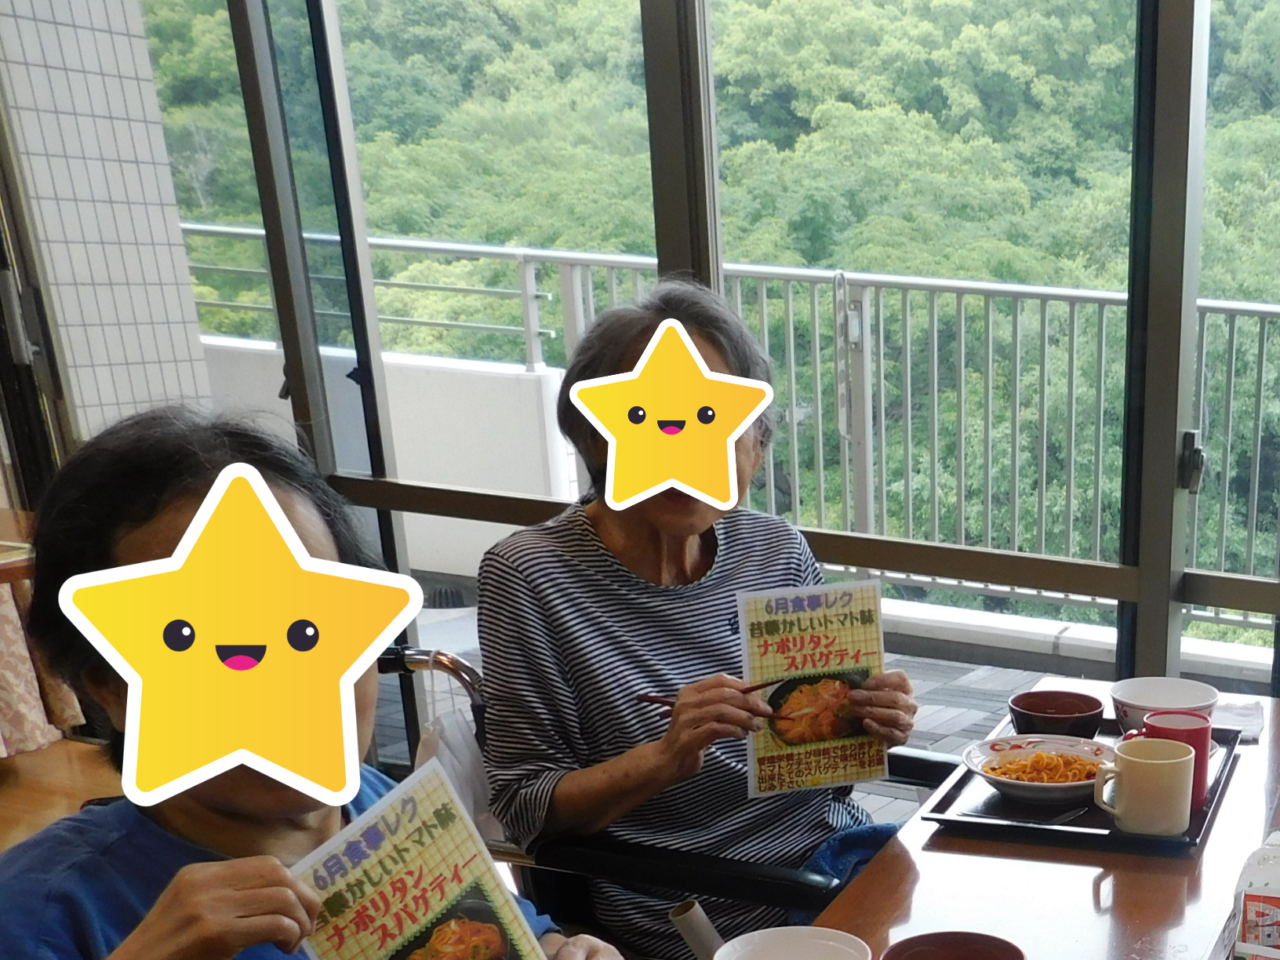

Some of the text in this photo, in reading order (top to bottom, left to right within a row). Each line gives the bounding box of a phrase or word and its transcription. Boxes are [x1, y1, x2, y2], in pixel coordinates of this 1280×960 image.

[765, 589, 853, 615] 6月食事レク
[757, 633, 838, 657] ナポリタン
[784, 648, 878, 672] スパゲティー
[313, 795, 417, 891] 6月食事レク
[326, 863, 422, 950] ナポリタン
[368, 852, 478, 950] スパゲティー
